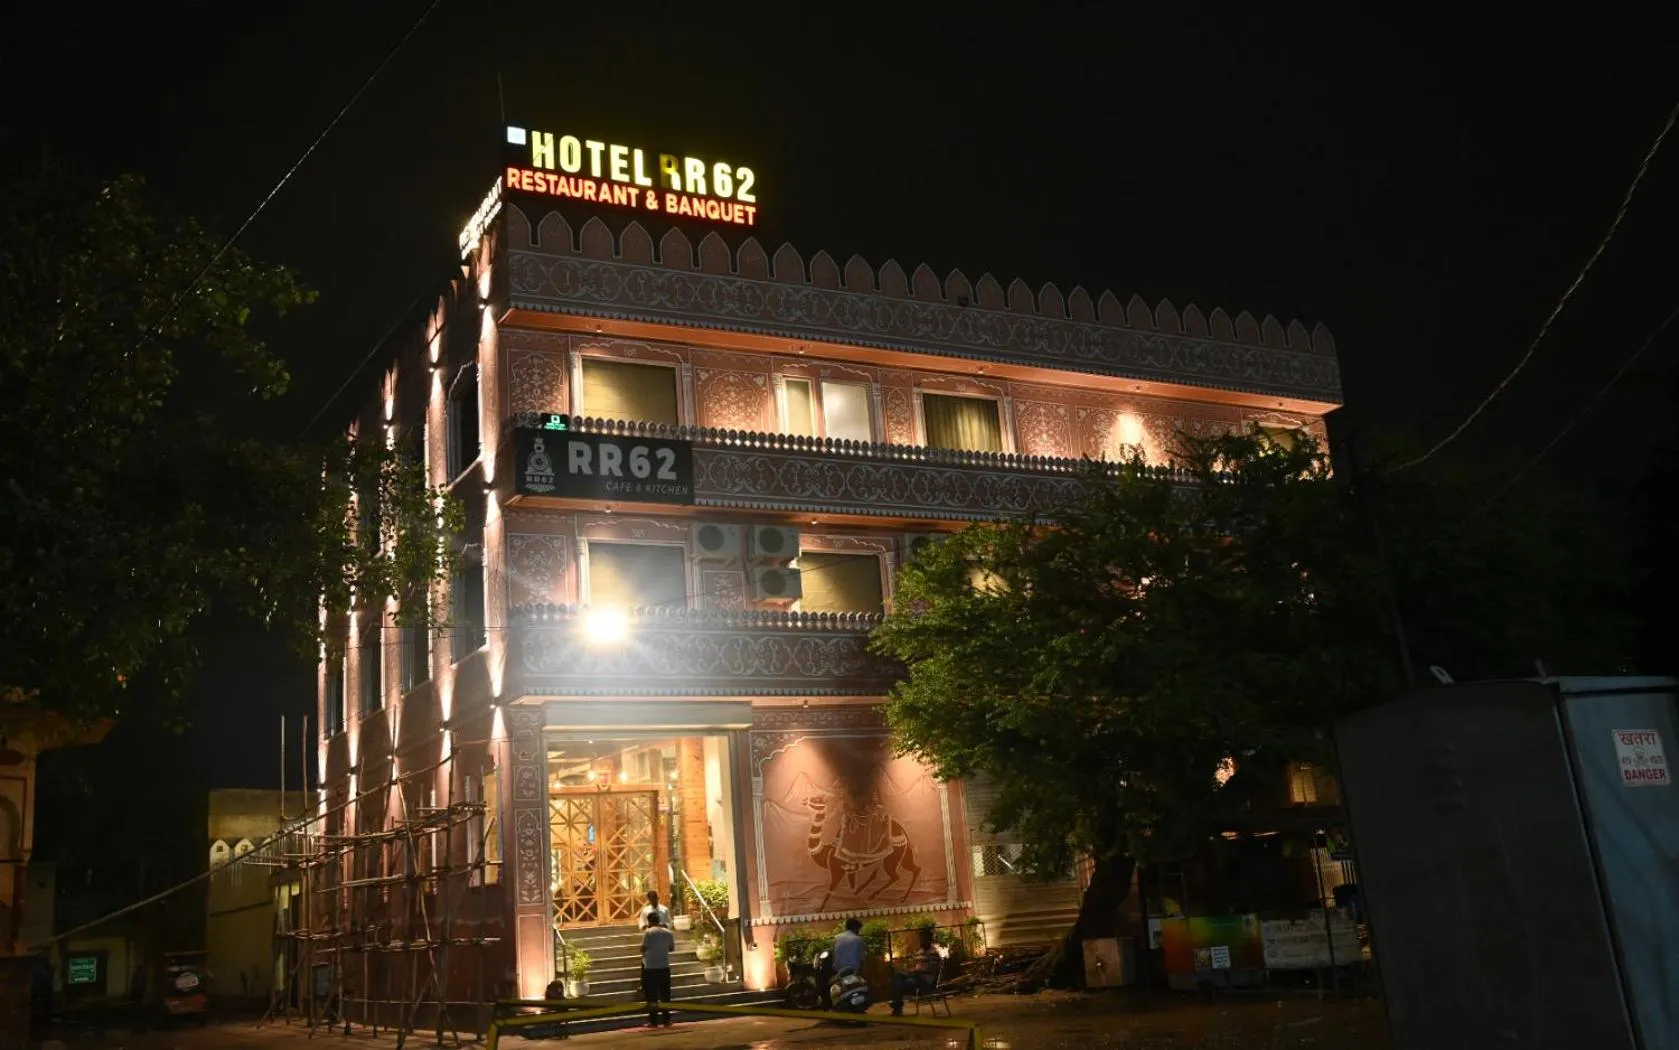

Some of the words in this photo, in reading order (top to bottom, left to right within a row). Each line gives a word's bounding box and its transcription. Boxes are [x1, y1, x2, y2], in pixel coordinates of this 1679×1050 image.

[531, 130, 652, 187] HOTEL
[659, 152, 756, 203] RR62
[506, 166, 640, 209] RESTAURANT
[645, 190, 659, 211] &
[665, 193, 757, 226] BANQUET
[568, 440, 678, 481] RR62
[605, 480, 632, 493] CAFE
[645, 483, 689, 497] KITCHEN
[1617, 732, 1656, 746] खतरा
[1624, 768, 1666, 780] DANGER
